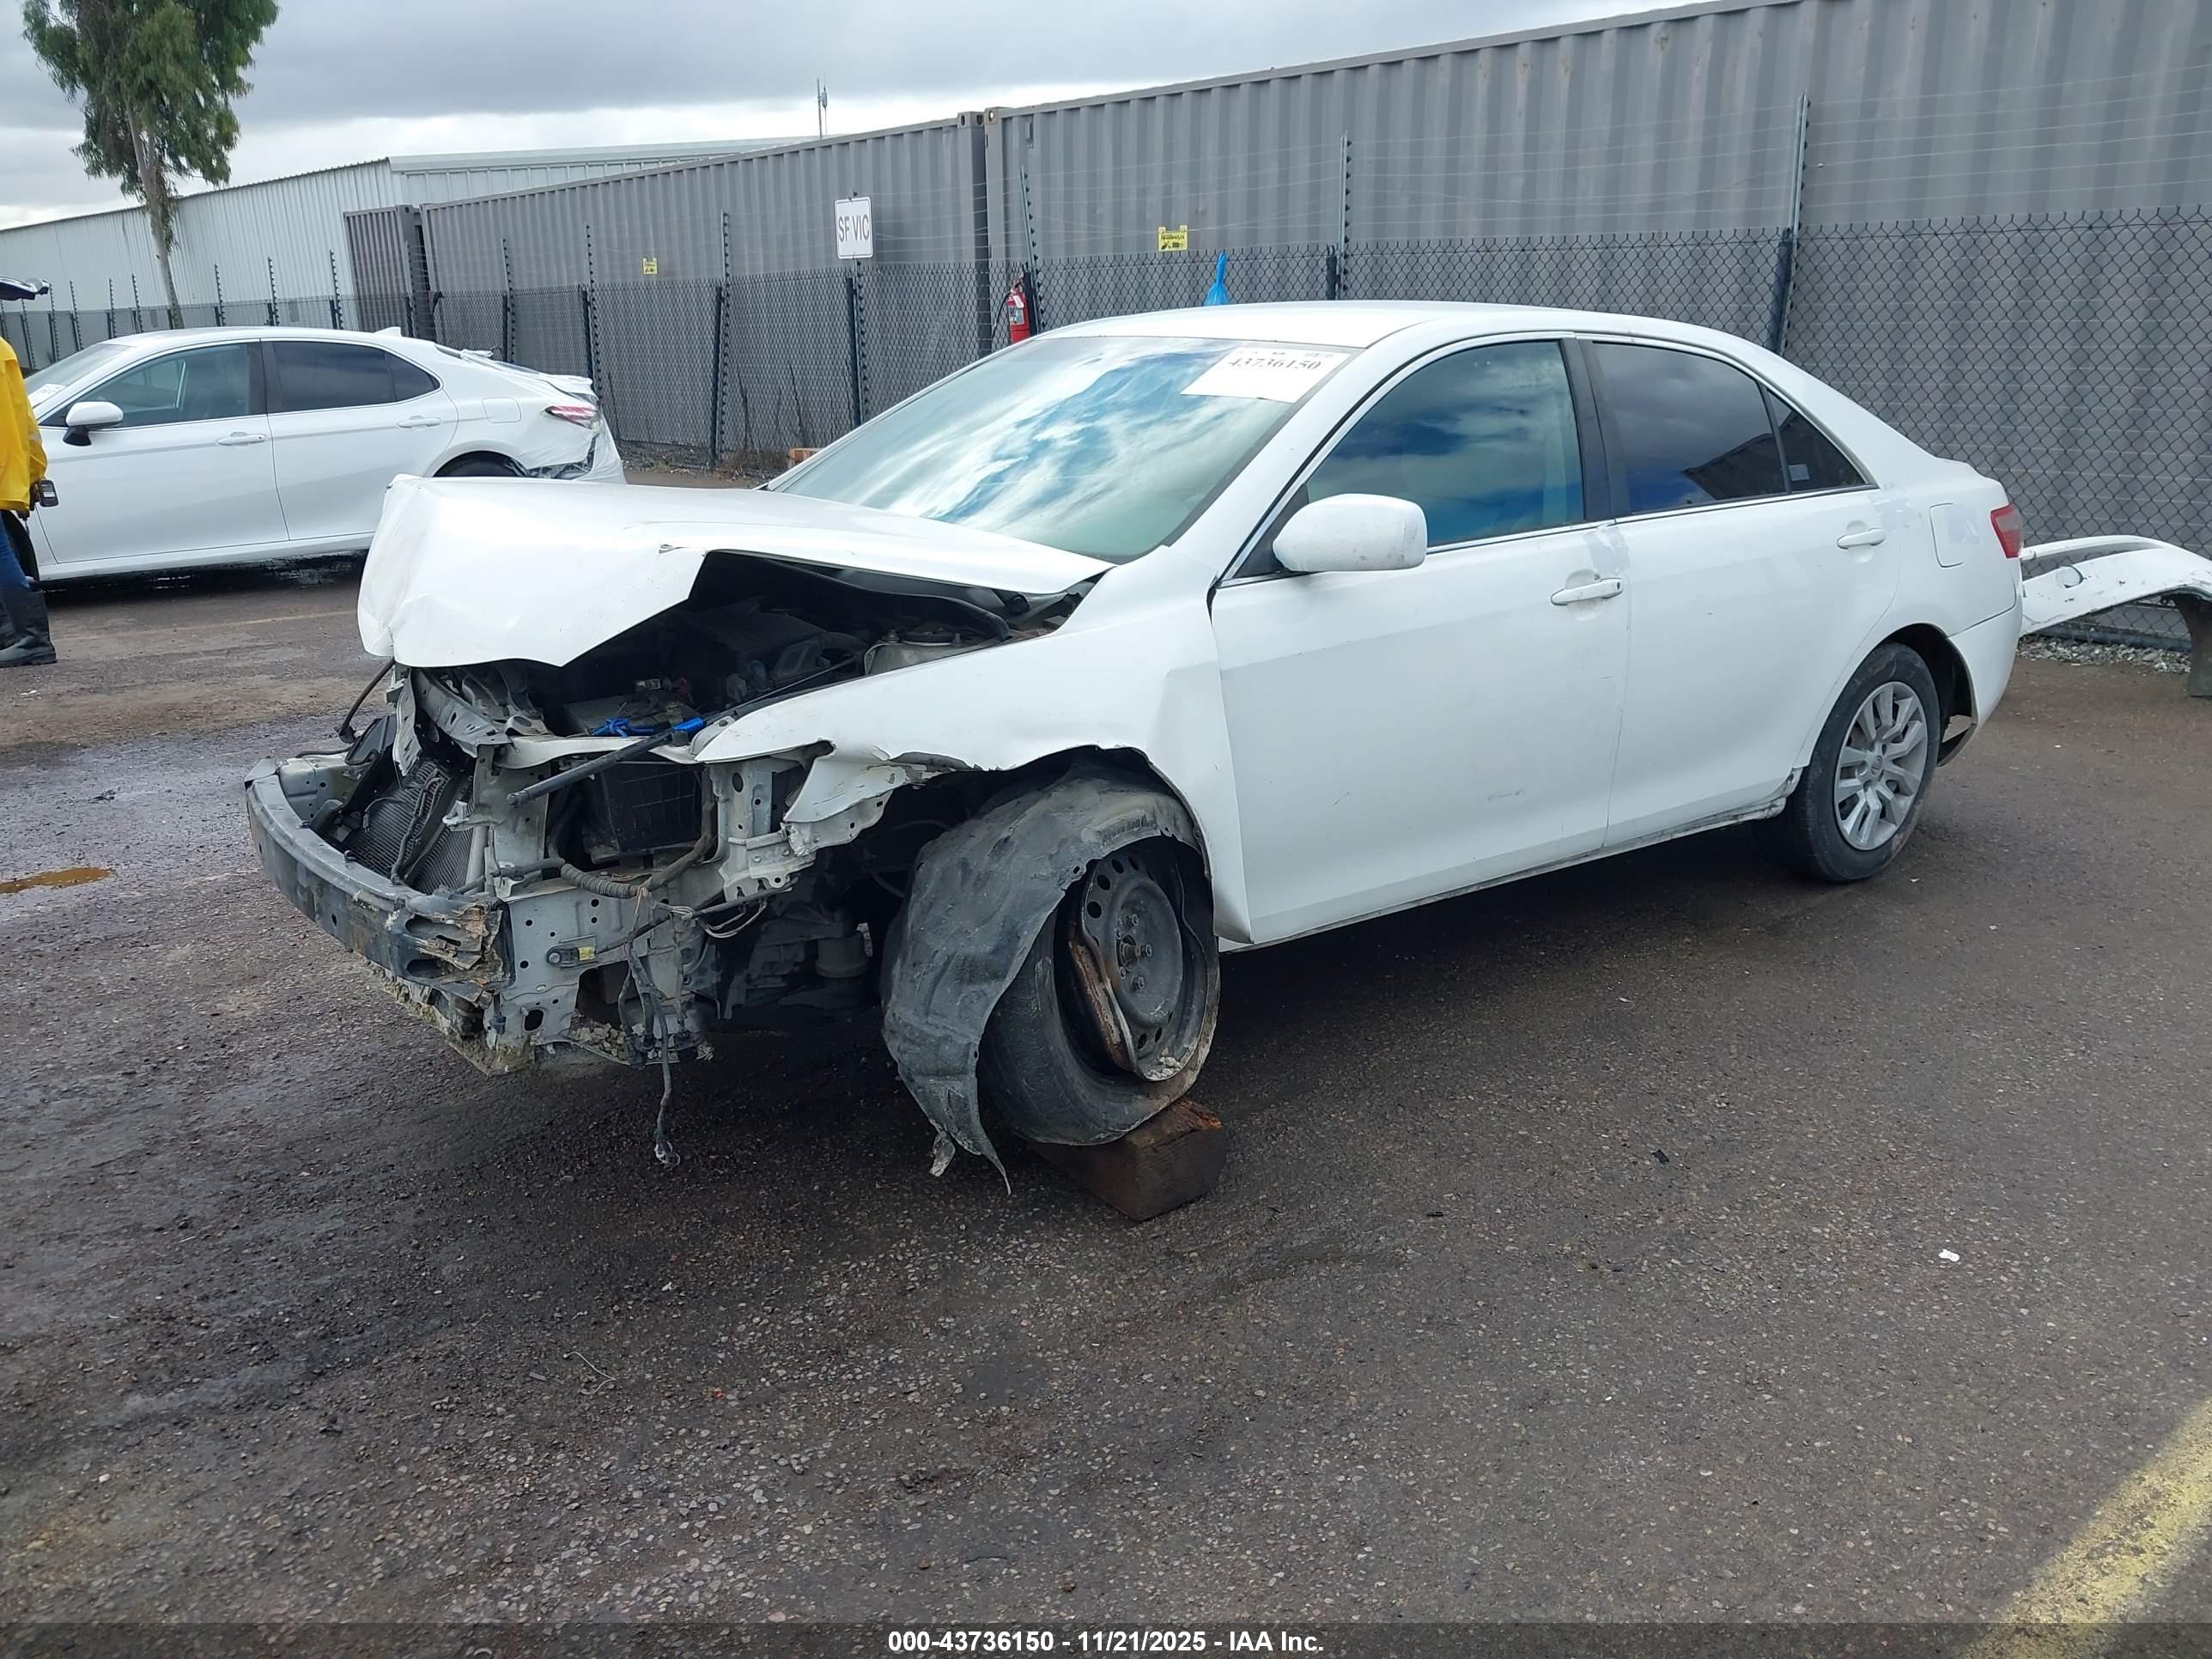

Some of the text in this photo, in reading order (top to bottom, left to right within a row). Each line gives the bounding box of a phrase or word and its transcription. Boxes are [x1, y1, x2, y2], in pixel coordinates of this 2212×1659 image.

[838, 213, 870, 242] SF VIC
[1228, 357, 1322, 370] 43736150
